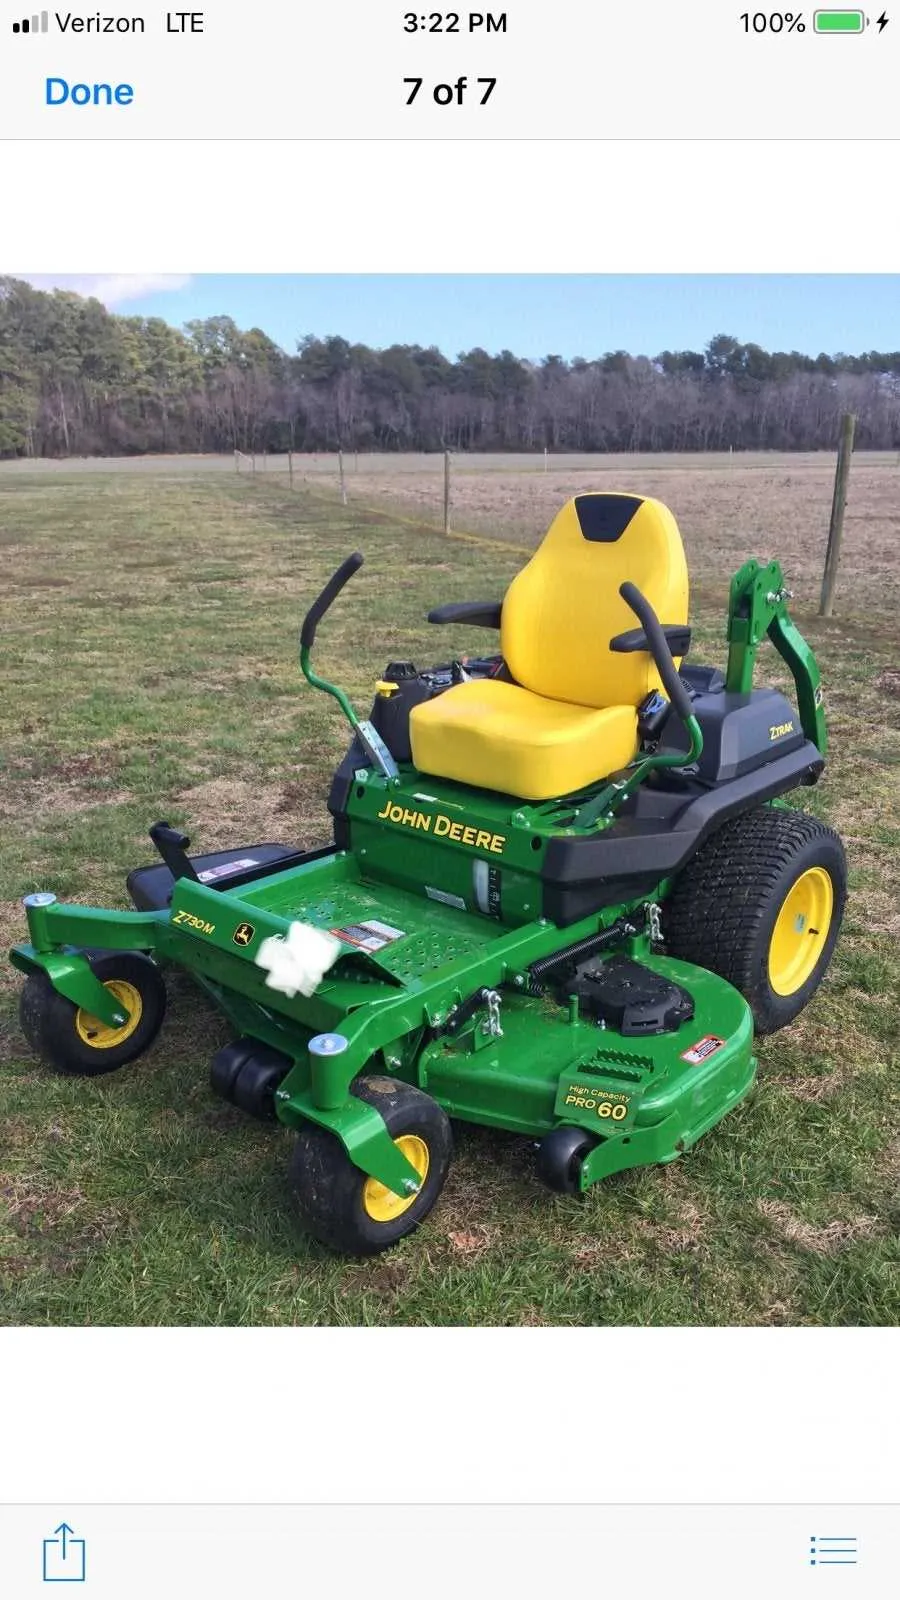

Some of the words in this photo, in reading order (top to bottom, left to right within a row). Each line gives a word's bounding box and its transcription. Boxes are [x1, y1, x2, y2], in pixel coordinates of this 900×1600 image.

[54, 12, 146, 34] Verizon
[165, 12, 205, 34] LTE
[403, 12, 460, 34] 3:22
[467, 12, 508, 34] PM
[739, 12, 807, 34] 100%
[45, 76, 134, 106] Done
[403, 76, 424, 106] 7
[432, 76, 468, 106] of
[476, 76, 498, 106] 7
[769, 721, 794, 740] ZTRAK
[378, 800, 431, 832] JOHN
[433, 814, 506, 854] DEERE
[172, 910, 216, 934] Z730M
[569, 1085, 590, 1095] High
[590, 1089, 631, 1103] Capacity
[565, 1095, 597, 1109] PRO
[597, 1101, 628, 1121] 60
